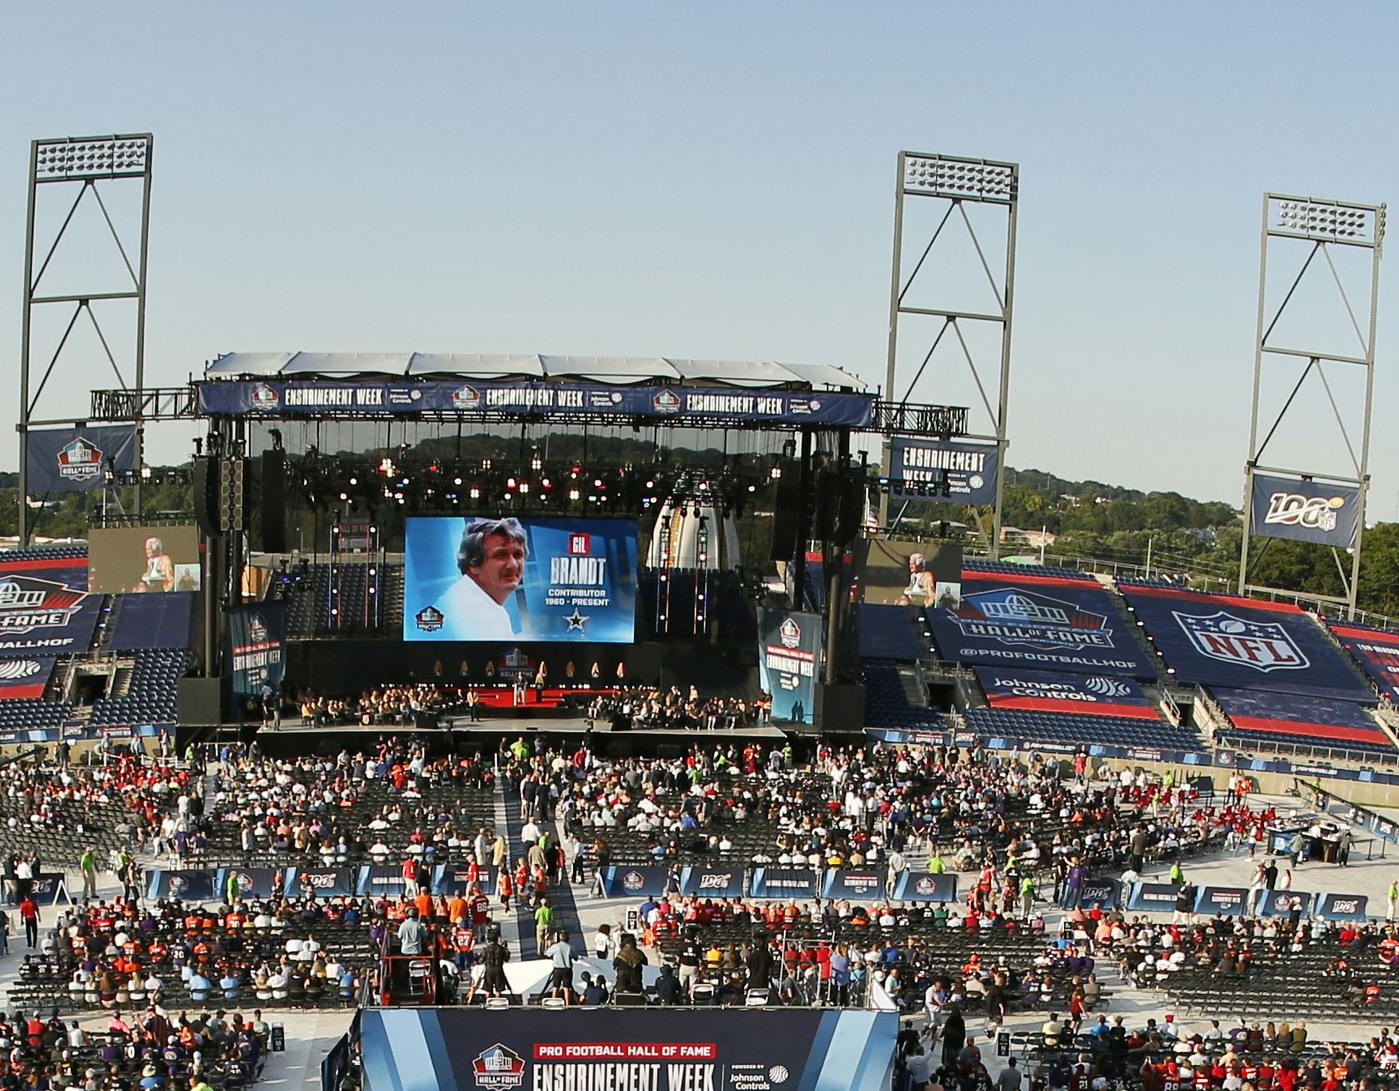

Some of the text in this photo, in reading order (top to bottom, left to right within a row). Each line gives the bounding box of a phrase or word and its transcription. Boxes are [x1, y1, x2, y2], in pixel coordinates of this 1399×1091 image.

[285, 388, 383, 406] ENSHRINEMENT WEEK
[486, 389, 583, 407] ENSHRINEMENT WEEK
[686, 393, 783, 415] ENSHRINEMENT WEEK
[903, 447, 985, 472] ENSHRINEMENT
[572, 536, 586, 553] GIL
[550, 557, 607, 585] BRANDT
[548, 589, 606, 597] CONTRIBUTOR
[0, 613, 62, 627] FAME
[970, 624, 1030, 638] HALL
[1043, 631, 1106, 645] FAME
[1202, 634, 1296, 664] NFL
[960, 648, 1137, 669] @PROFOOTBALLHOF
[993, 677, 1076, 692] Johnson
[1012, 687, 1097, 702] Controls
[457, 935, 471, 946] 27
[539, 1046, 711, 1056] PRO FOOTBALL HALL OF FAME
[480, 1076, 519, 1084] HALL FAME
[730, 1073, 764, 1083] Johnson
[735, 1081, 770, 1090] Controls
